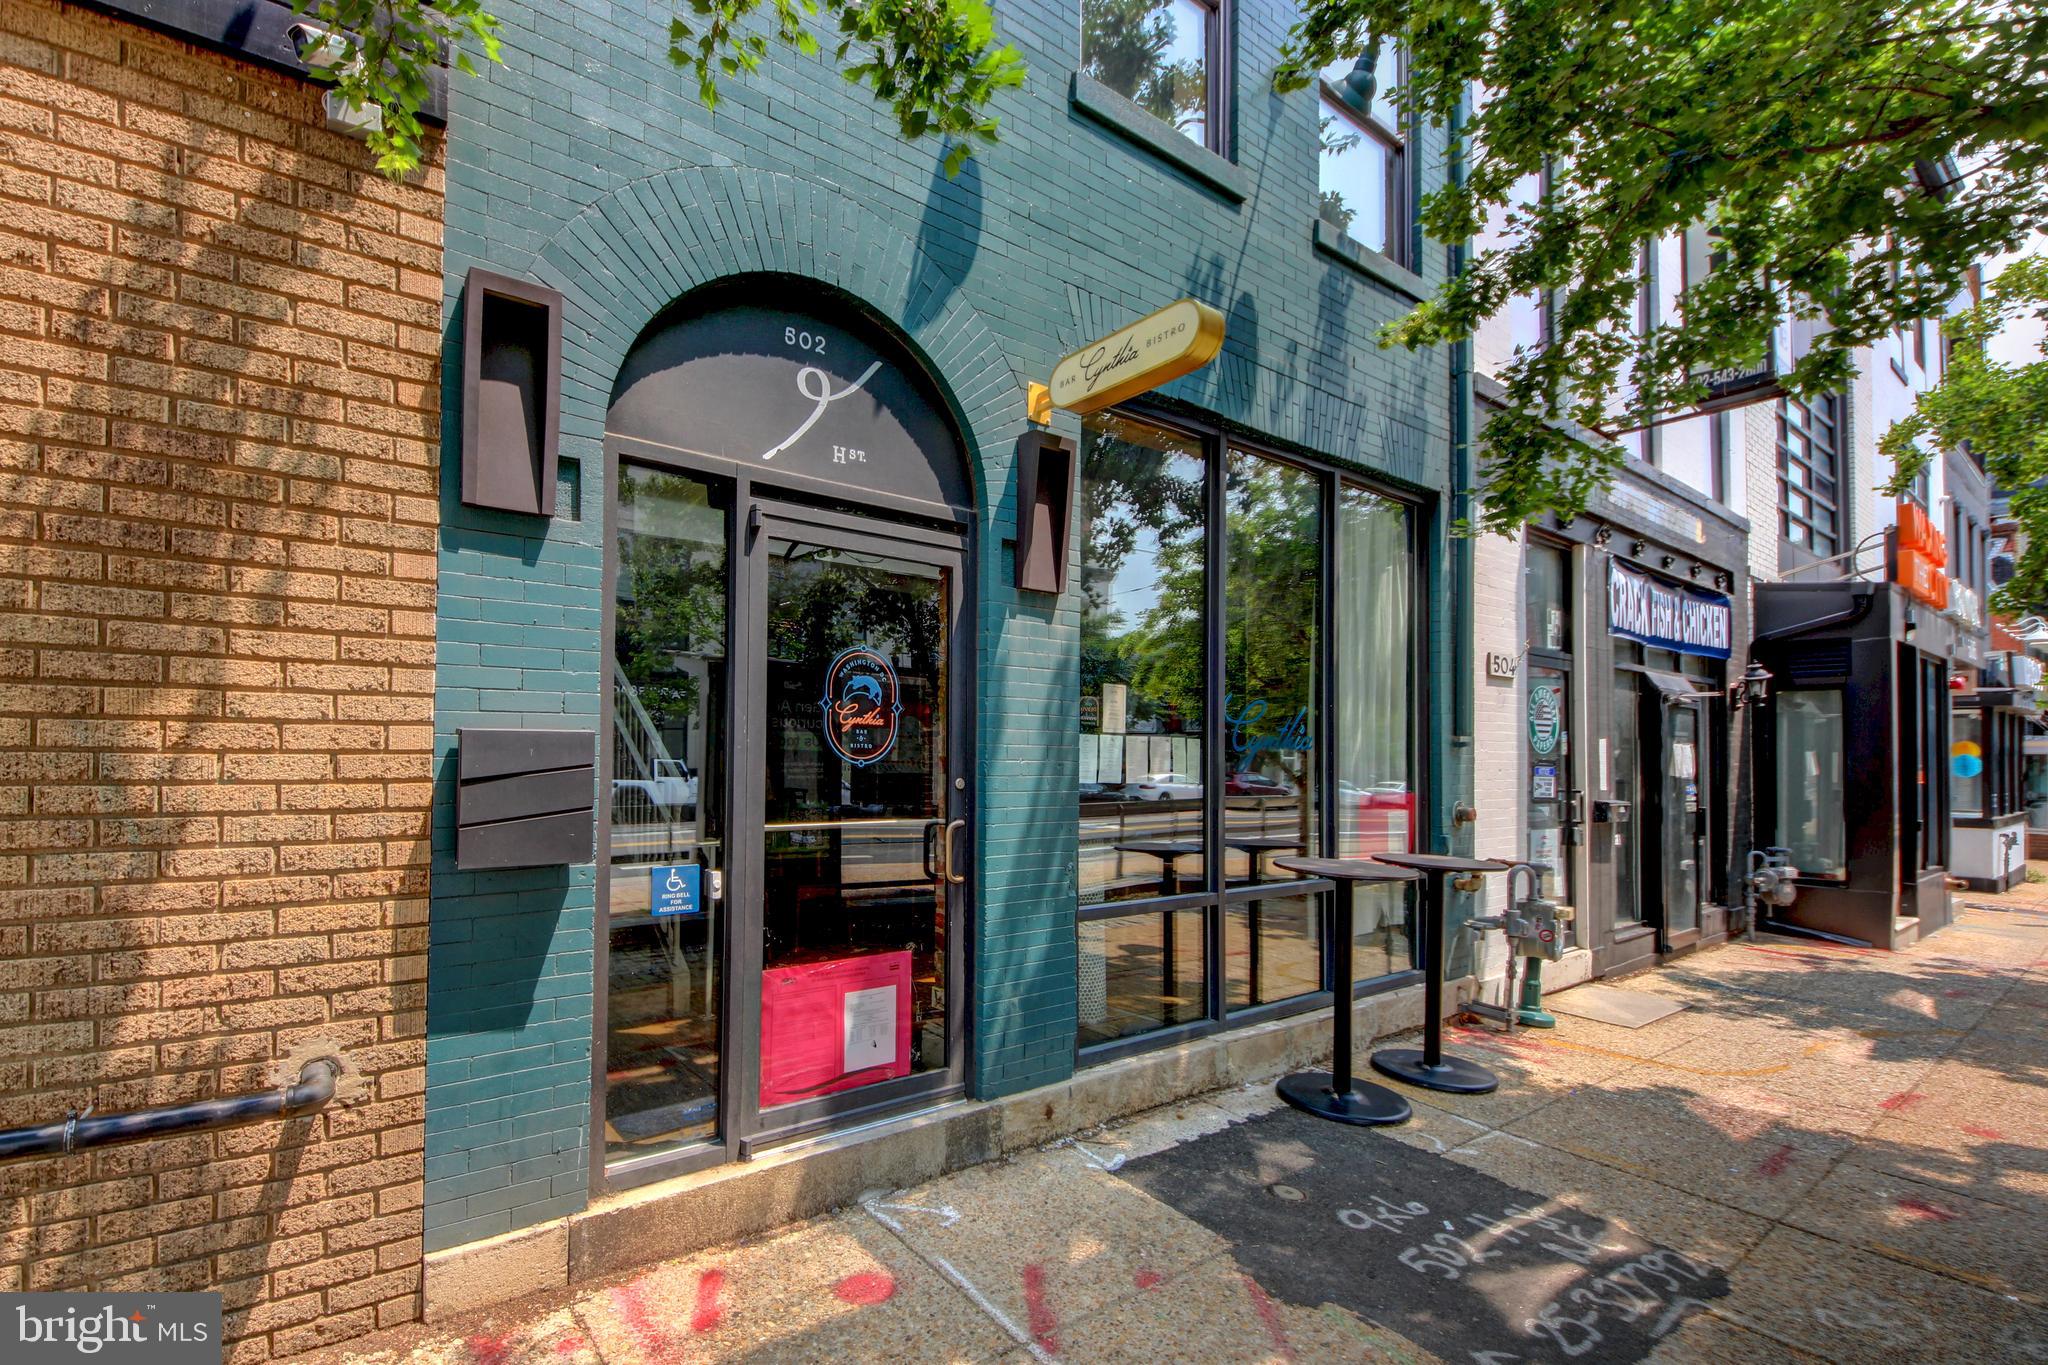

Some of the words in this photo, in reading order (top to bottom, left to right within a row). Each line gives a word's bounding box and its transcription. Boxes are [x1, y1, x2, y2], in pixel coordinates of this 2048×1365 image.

[785, 326, 826, 355] 502
[1060, 375, 1076, 388] BAR
[1080, 334, 1138, 392] Cynthia
[1146, 322, 1186, 348] BISTRO
[832, 445, 847, 464] H
[1611, 567, 1652, 637] CRACK
[1651, 588, 1674, 640] FISH
[1674, 597, 1682, 642] &
[1682, 600, 1729, 649] CHICKEN
[839, 659, 880, 678] WASHINGTON
[879, 671, 887, 683] DC
[1493, 655, 1516, 676] 504
[835, 700, 886, 732] Cynthia
[659, 904, 693, 912] ASSISTANCE
